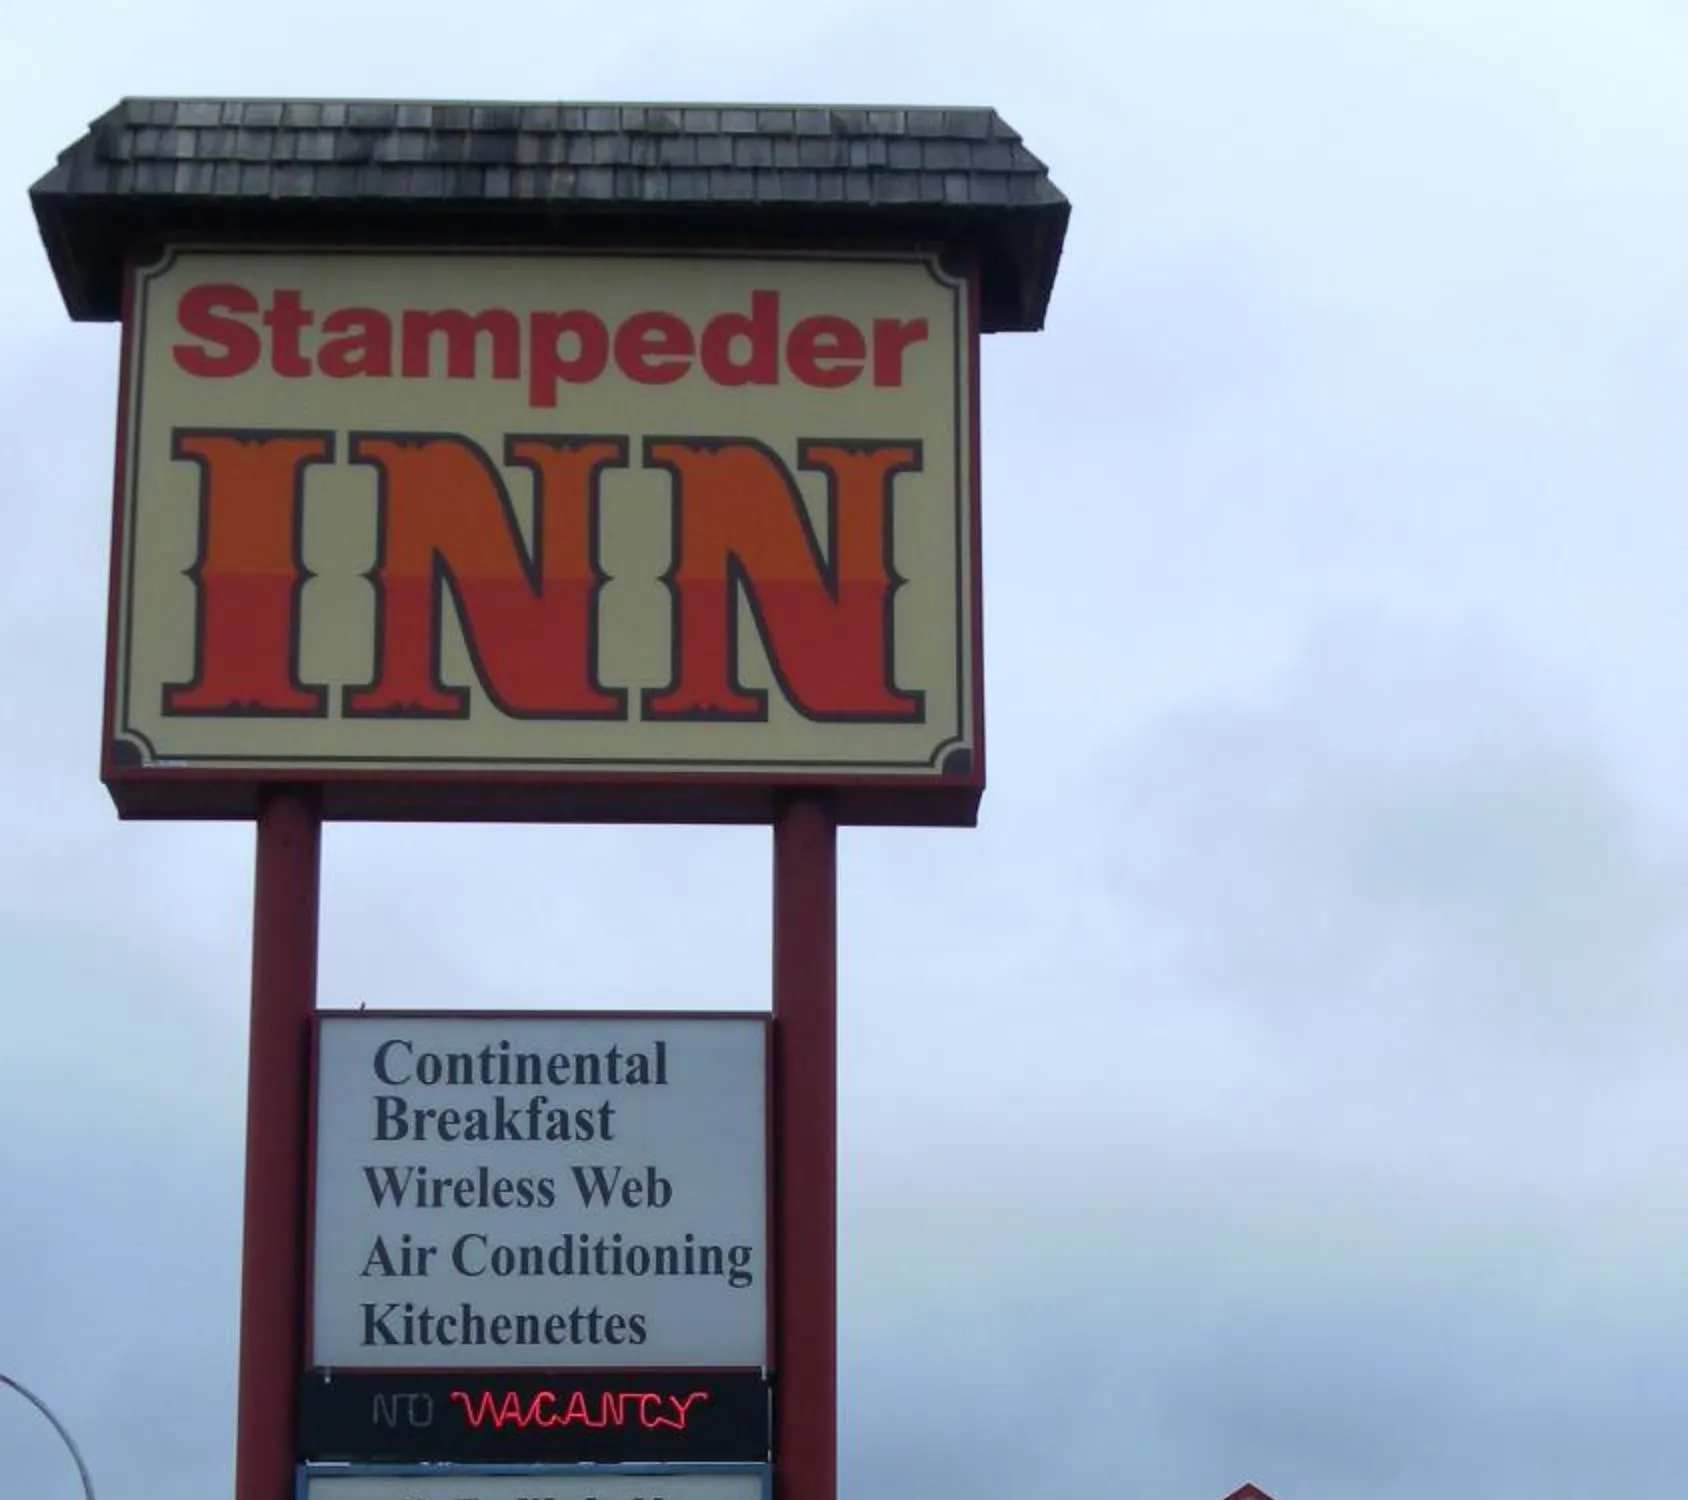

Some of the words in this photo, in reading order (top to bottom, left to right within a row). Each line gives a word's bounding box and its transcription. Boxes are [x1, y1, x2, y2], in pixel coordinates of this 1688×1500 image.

[172, 282, 929, 408] Stampeder
[161, 426, 925, 724] INN
[373, 1039, 668, 1086] Continental
[374, 1095, 616, 1142] Breakfast
[363, 1165, 555, 1208] Wireless
[571, 1165, 673, 1208] Web
[360, 1233, 438, 1277] Air
[451, 1233, 754, 1289] Conditioning
[361, 1303, 648, 1347] Kitchenettes
[372, 1393, 434, 1428] NO
